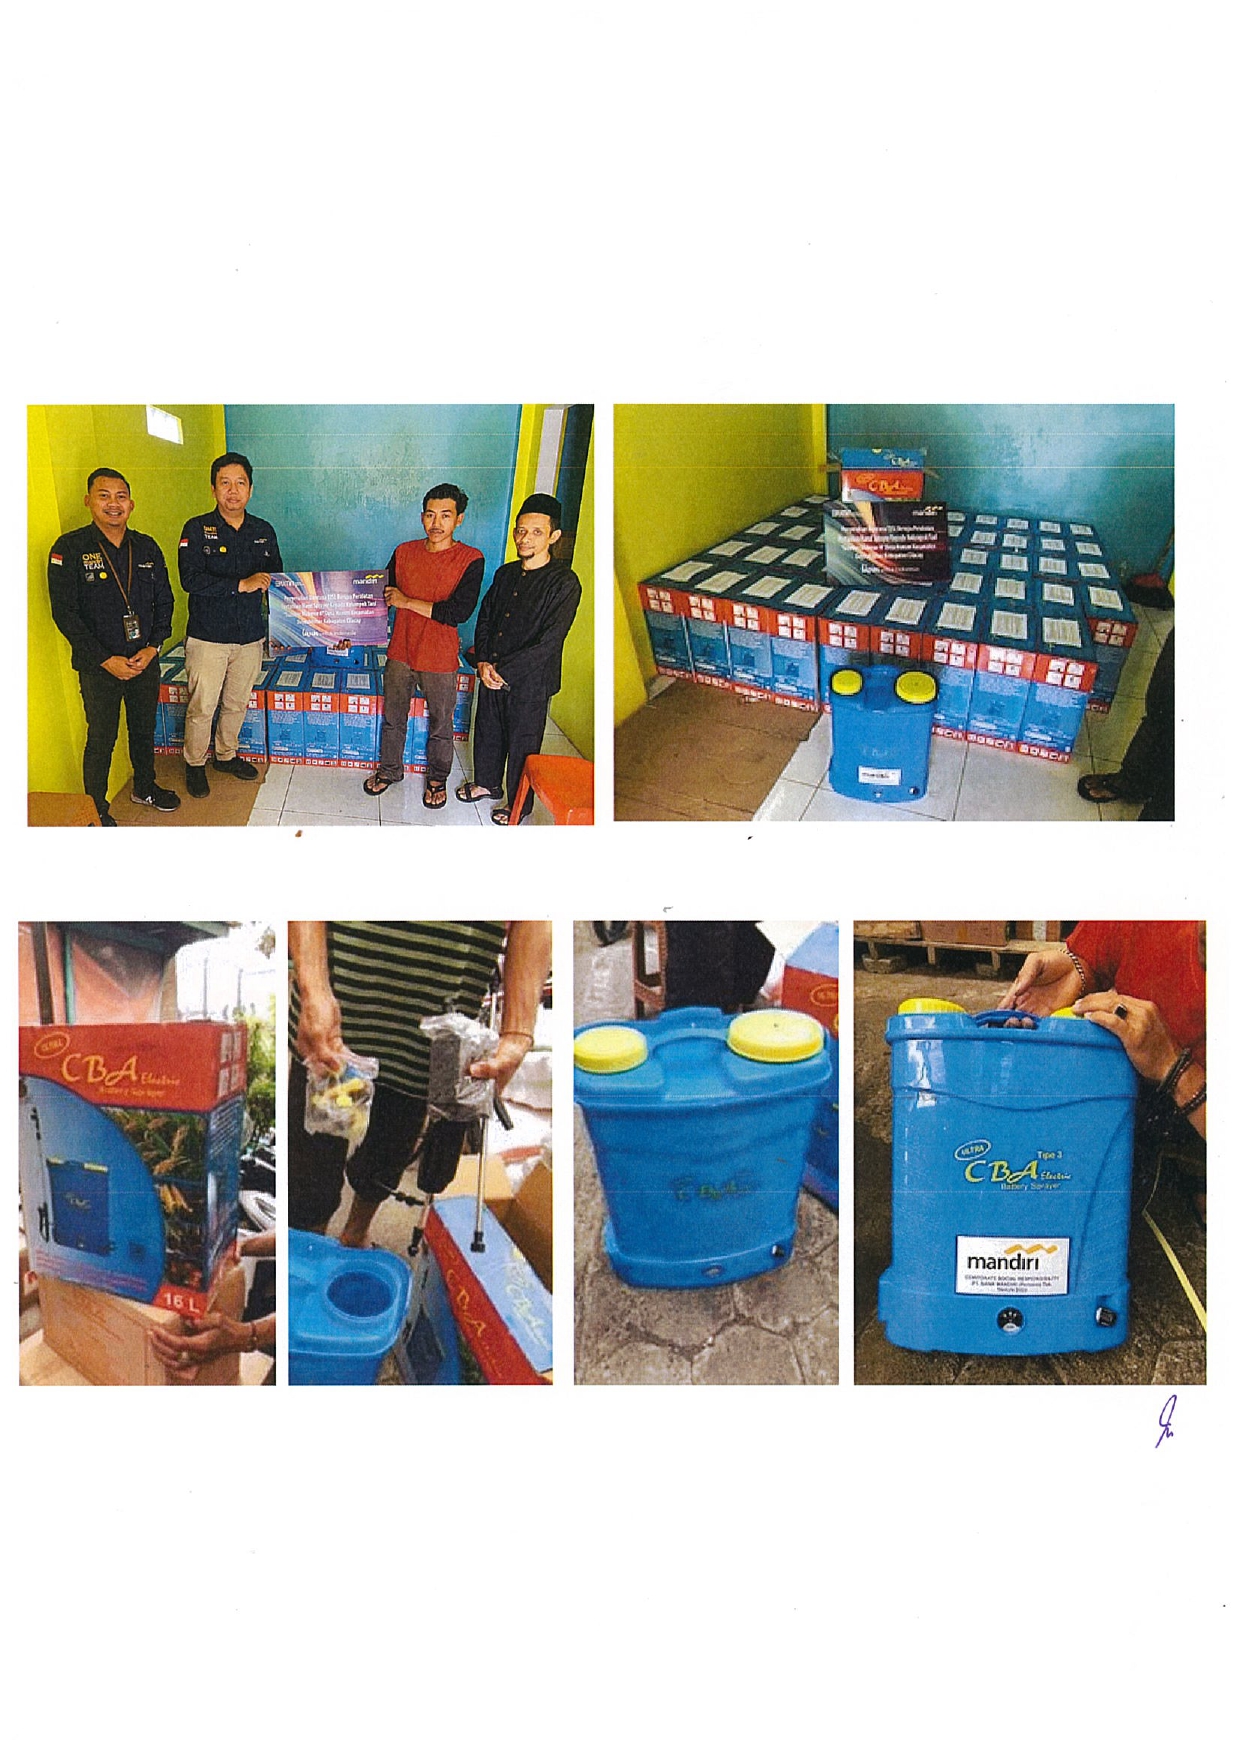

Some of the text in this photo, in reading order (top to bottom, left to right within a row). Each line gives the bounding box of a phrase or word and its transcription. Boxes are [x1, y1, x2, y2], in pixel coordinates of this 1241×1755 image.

[82, 552, 101, 561] ONE
[61, 1053, 138, 1087] CBA
[961, 1144, 1063, 1161] ULTRA Tipe 3
[964, 1159, 1071, 1184] CBA Electric
[1001, 1182, 1061, 1191] Battery Sprayer
[967, 1252, 1040, 1271] mandiri
[163, 1292, 201, 1313] 16 L
